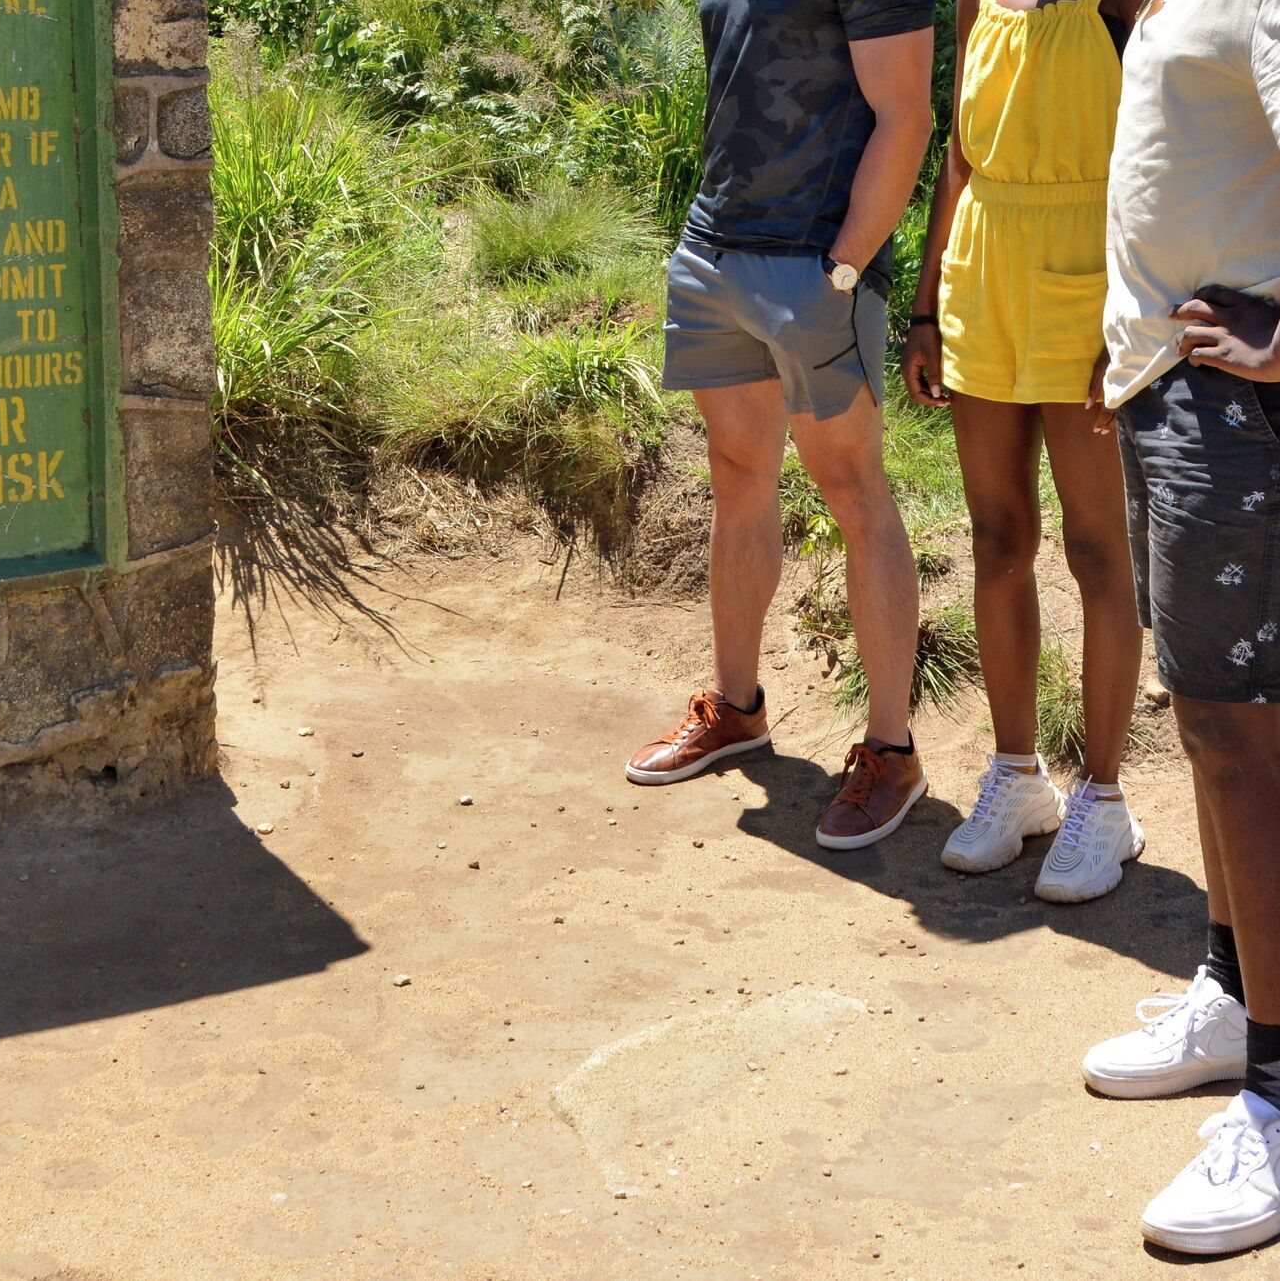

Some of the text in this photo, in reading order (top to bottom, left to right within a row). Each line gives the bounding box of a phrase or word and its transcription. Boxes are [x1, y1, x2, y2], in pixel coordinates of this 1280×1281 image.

[30, 130, 59, 166] IF
[3, 219, 66, 256] AND
[19, 308, 57, 343] TO
